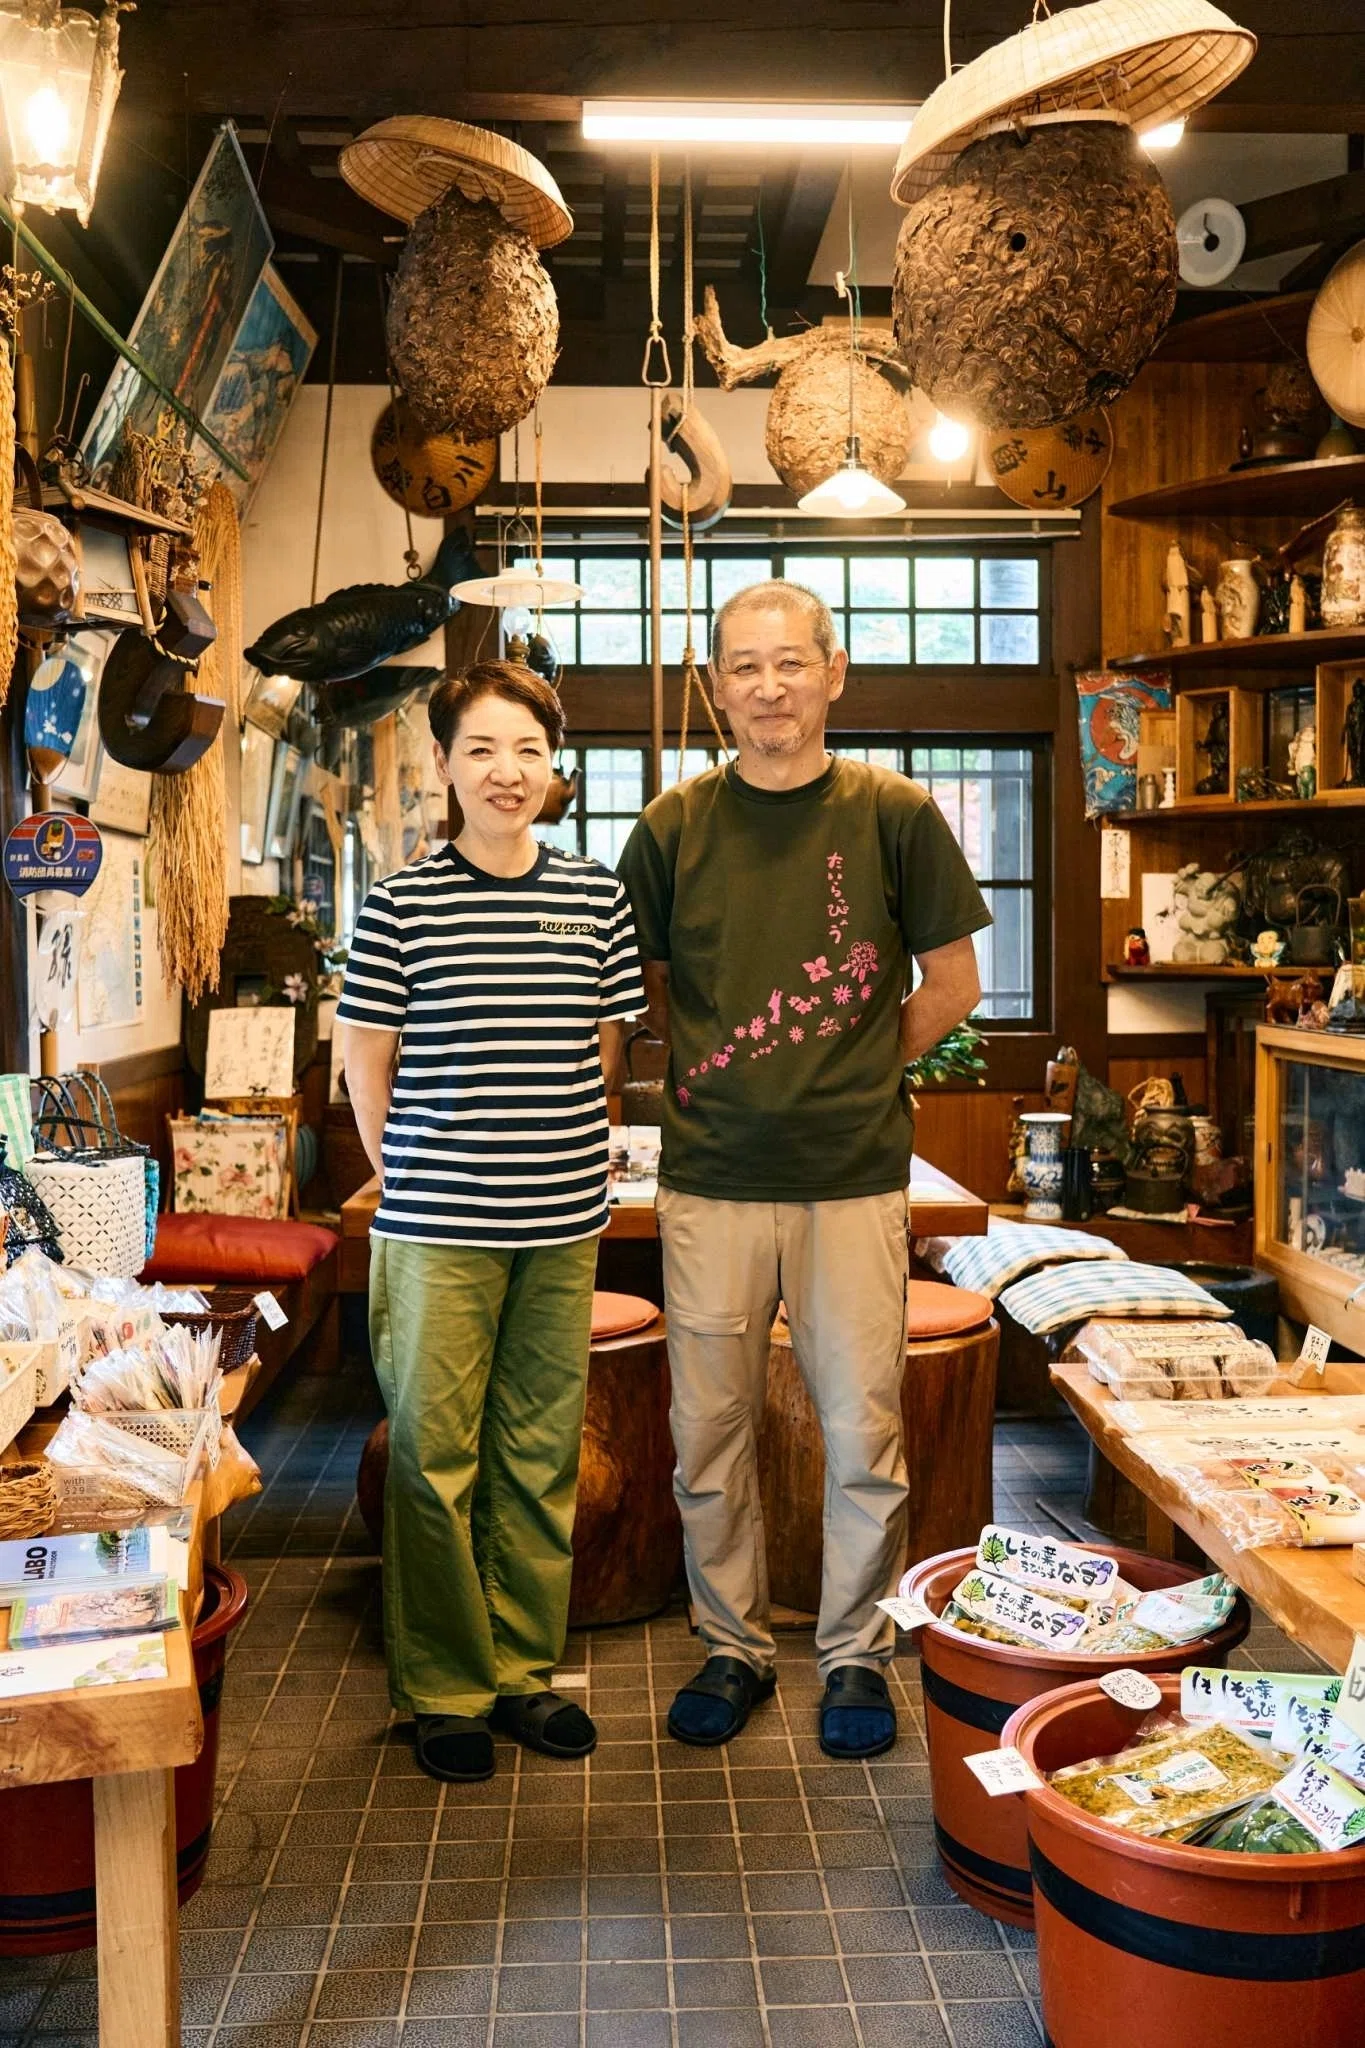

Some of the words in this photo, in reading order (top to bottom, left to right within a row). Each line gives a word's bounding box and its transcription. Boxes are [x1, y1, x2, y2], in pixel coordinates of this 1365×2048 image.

[827, 852, 850, 944] たいらっぴょう
[63, 1476, 85, 1486] with
[22, 1546, 48, 1581] LABO
